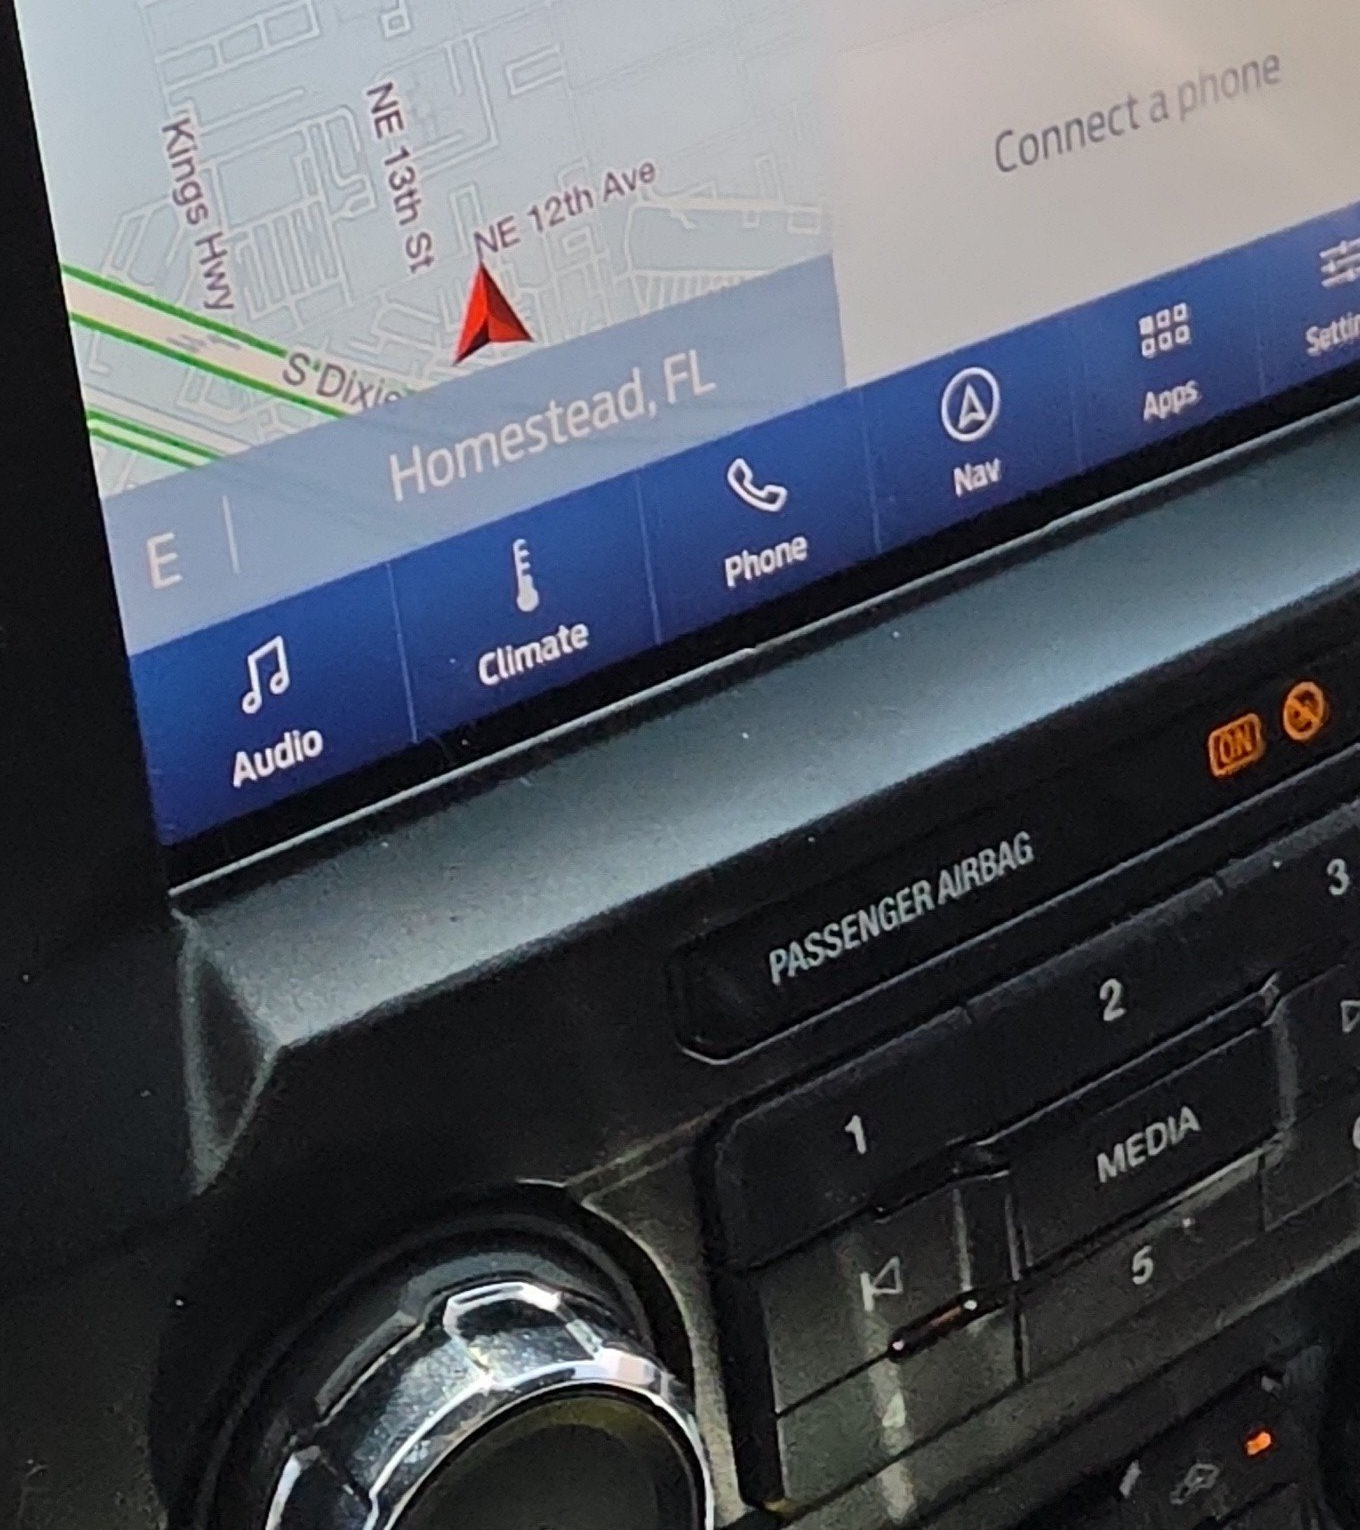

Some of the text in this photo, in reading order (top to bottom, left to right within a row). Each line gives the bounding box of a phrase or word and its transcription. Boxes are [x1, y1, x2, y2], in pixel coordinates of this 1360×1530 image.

[995, 54, 1281, 173] Connect a phone
[366, 81, 435, 273] NE 13th St
[162, 118, 234, 310] Kings Hwy
[474, 162, 657, 261] NE 12th Ave
[282, 352, 311, 386] S
[390, 348, 717, 501] Homestead, FL
[1143, 378, 1200, 420] Apps
[953, 458, 1001, 497] Nav
[146, 532, 183, 589] E
[724, 535, 808, 587] Phone
[478, 622, 589, 686] Climate
[232, 728, 324, 788] Audio
[1326, 857, 1351, 895] 3
[768, 830, 1034, 984] PASSENGER AIRBAG
[1099, 979, 1125, 1021] 2
[845, 1115, 868, 1154] 1
[1096, 1106, 1201, 1183] MEDIA
[1131, 1245, 1155, 1285] 5
